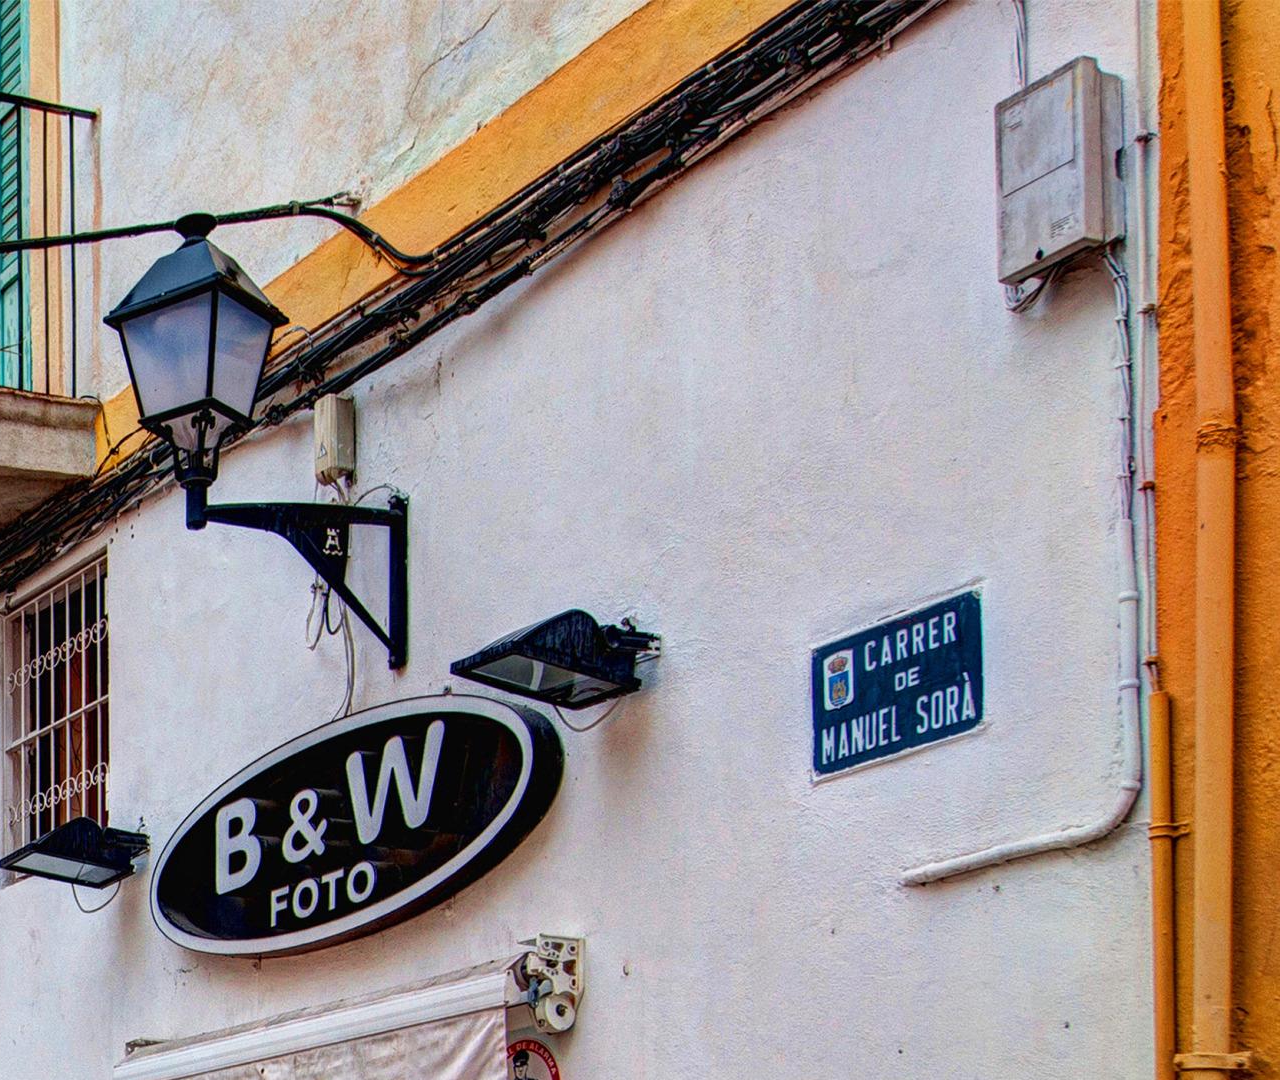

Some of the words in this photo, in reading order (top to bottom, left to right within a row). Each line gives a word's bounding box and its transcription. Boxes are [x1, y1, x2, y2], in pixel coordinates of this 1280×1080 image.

[864, 611, 957, 671] CARRER
[895, 666, 921, 692] DE
[822, 705, 901, 765] MANUEL
[916, 672, 976, 734] SORÀ
[215, 797, 262, 895] B
[281, 789, 328, 864] &
[346, 720, 445, 845] W
[270, 861, 377, 927] FOTO
